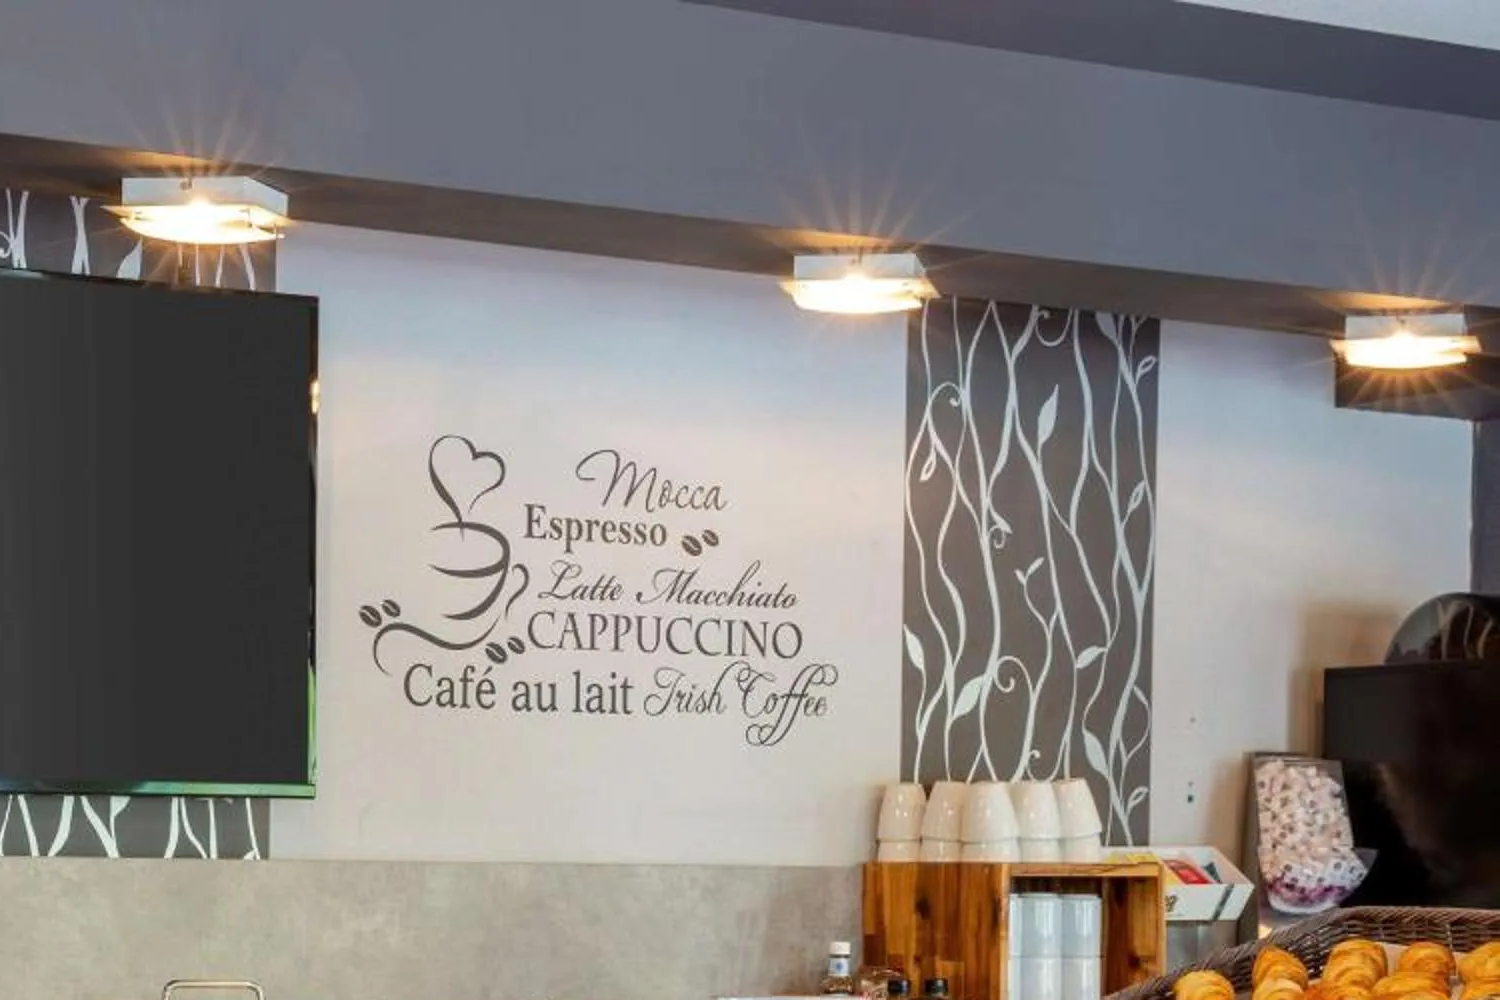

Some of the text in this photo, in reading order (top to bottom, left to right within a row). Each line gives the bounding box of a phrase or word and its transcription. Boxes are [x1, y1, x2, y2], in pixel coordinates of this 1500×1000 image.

[575, 450, 729, 513] Mocca
[524, 504, 667, 554] Espresso
[537, 560, 798, 609] Latte Macchiato
[527, 608, 803, 659] CAPPUCCINO
[404, 661, 838, 748] Café au lait Irish Coffee
